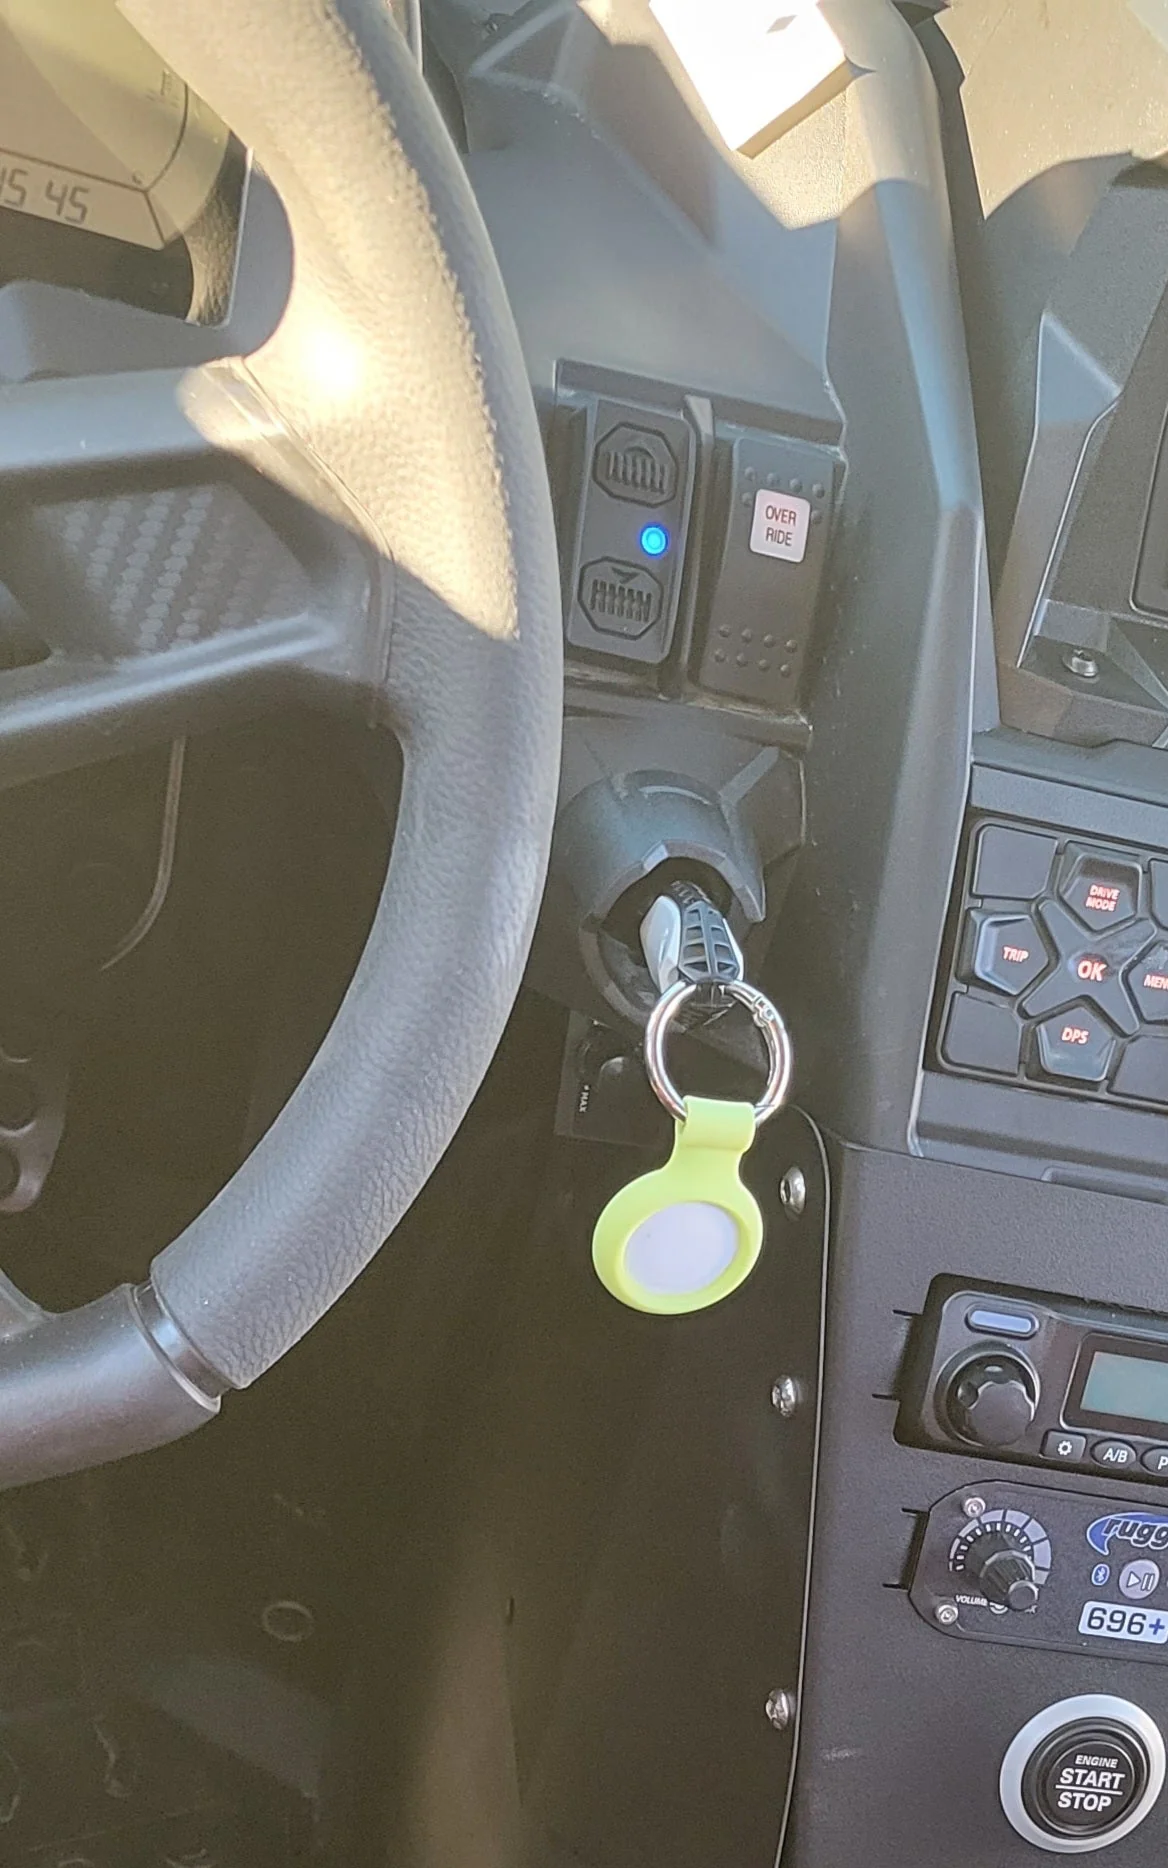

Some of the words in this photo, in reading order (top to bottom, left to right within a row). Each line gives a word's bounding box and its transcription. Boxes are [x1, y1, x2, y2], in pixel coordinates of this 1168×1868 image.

[765, 505, 797, 525] OVER
[765, 527, 793, 546] RIDE
[1089, 885, 1120, 900] DRIVE
[1085, 898, 1116, 911] MODE
[1002, 946, 1030, 963] TRIP
[1076, 960, 1108, 982] OK
[1061, 1027, 1090, 1045] DPS
[1102, 1445, 1128, 1464] A/B
[1085, 1605, 1166, 1637] 696+
[1075, 1754, 1119, 1768] ENGINE
[1059, 1767, 1126, 1790] START
[1057, 1791, 1112, 1812] STOP
